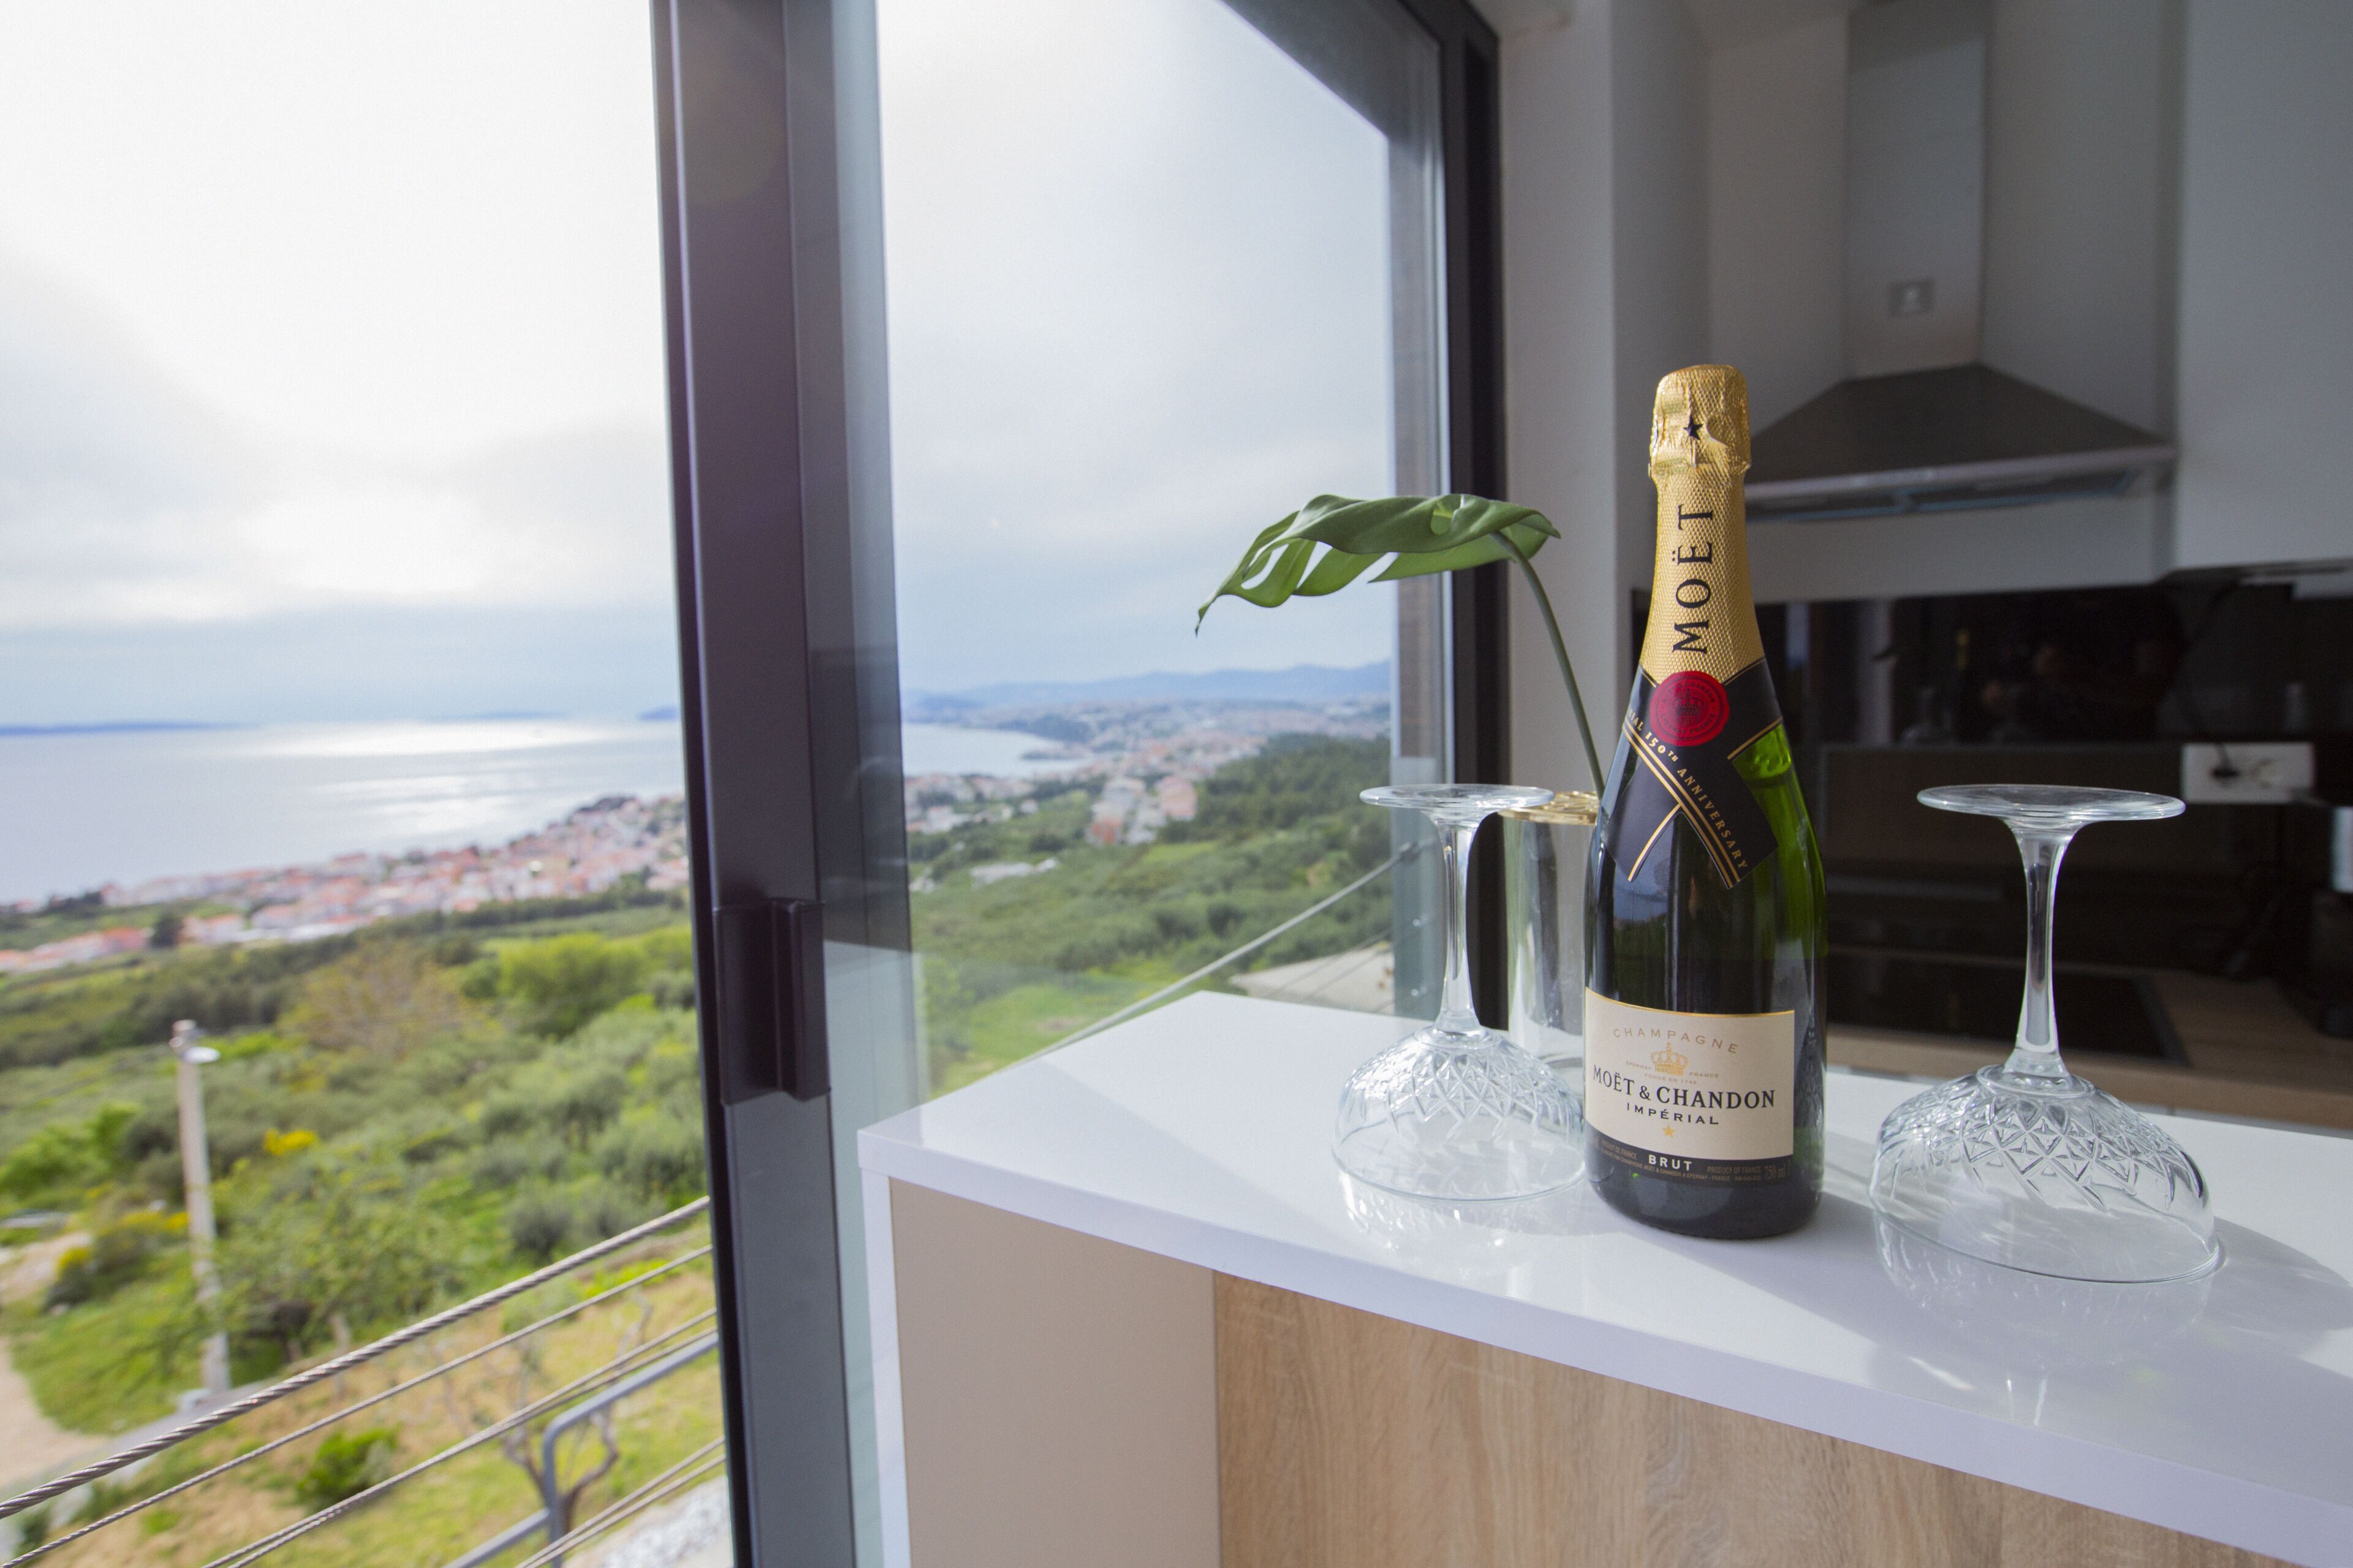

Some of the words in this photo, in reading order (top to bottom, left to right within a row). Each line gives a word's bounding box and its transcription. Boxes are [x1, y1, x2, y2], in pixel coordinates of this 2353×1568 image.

[1672, 504, 1713, 654] MOËT
[1645, 732, 1678, 762] 150TH
[1677, 768, 1748, 868] ANNIVERSARY
[1613, 1028, 1739, 1054] CHAMPAGNE
[1593, 1064, 1635, 1096] MOËT
[1639, 1085, 1651, 1101] &
[1656, 1086, 1775, 1109] CHANDON
[1627, 1102, 1719, 1125] IMPÉRIAL
[1648, 1154, 1692, 1171] BRUT
